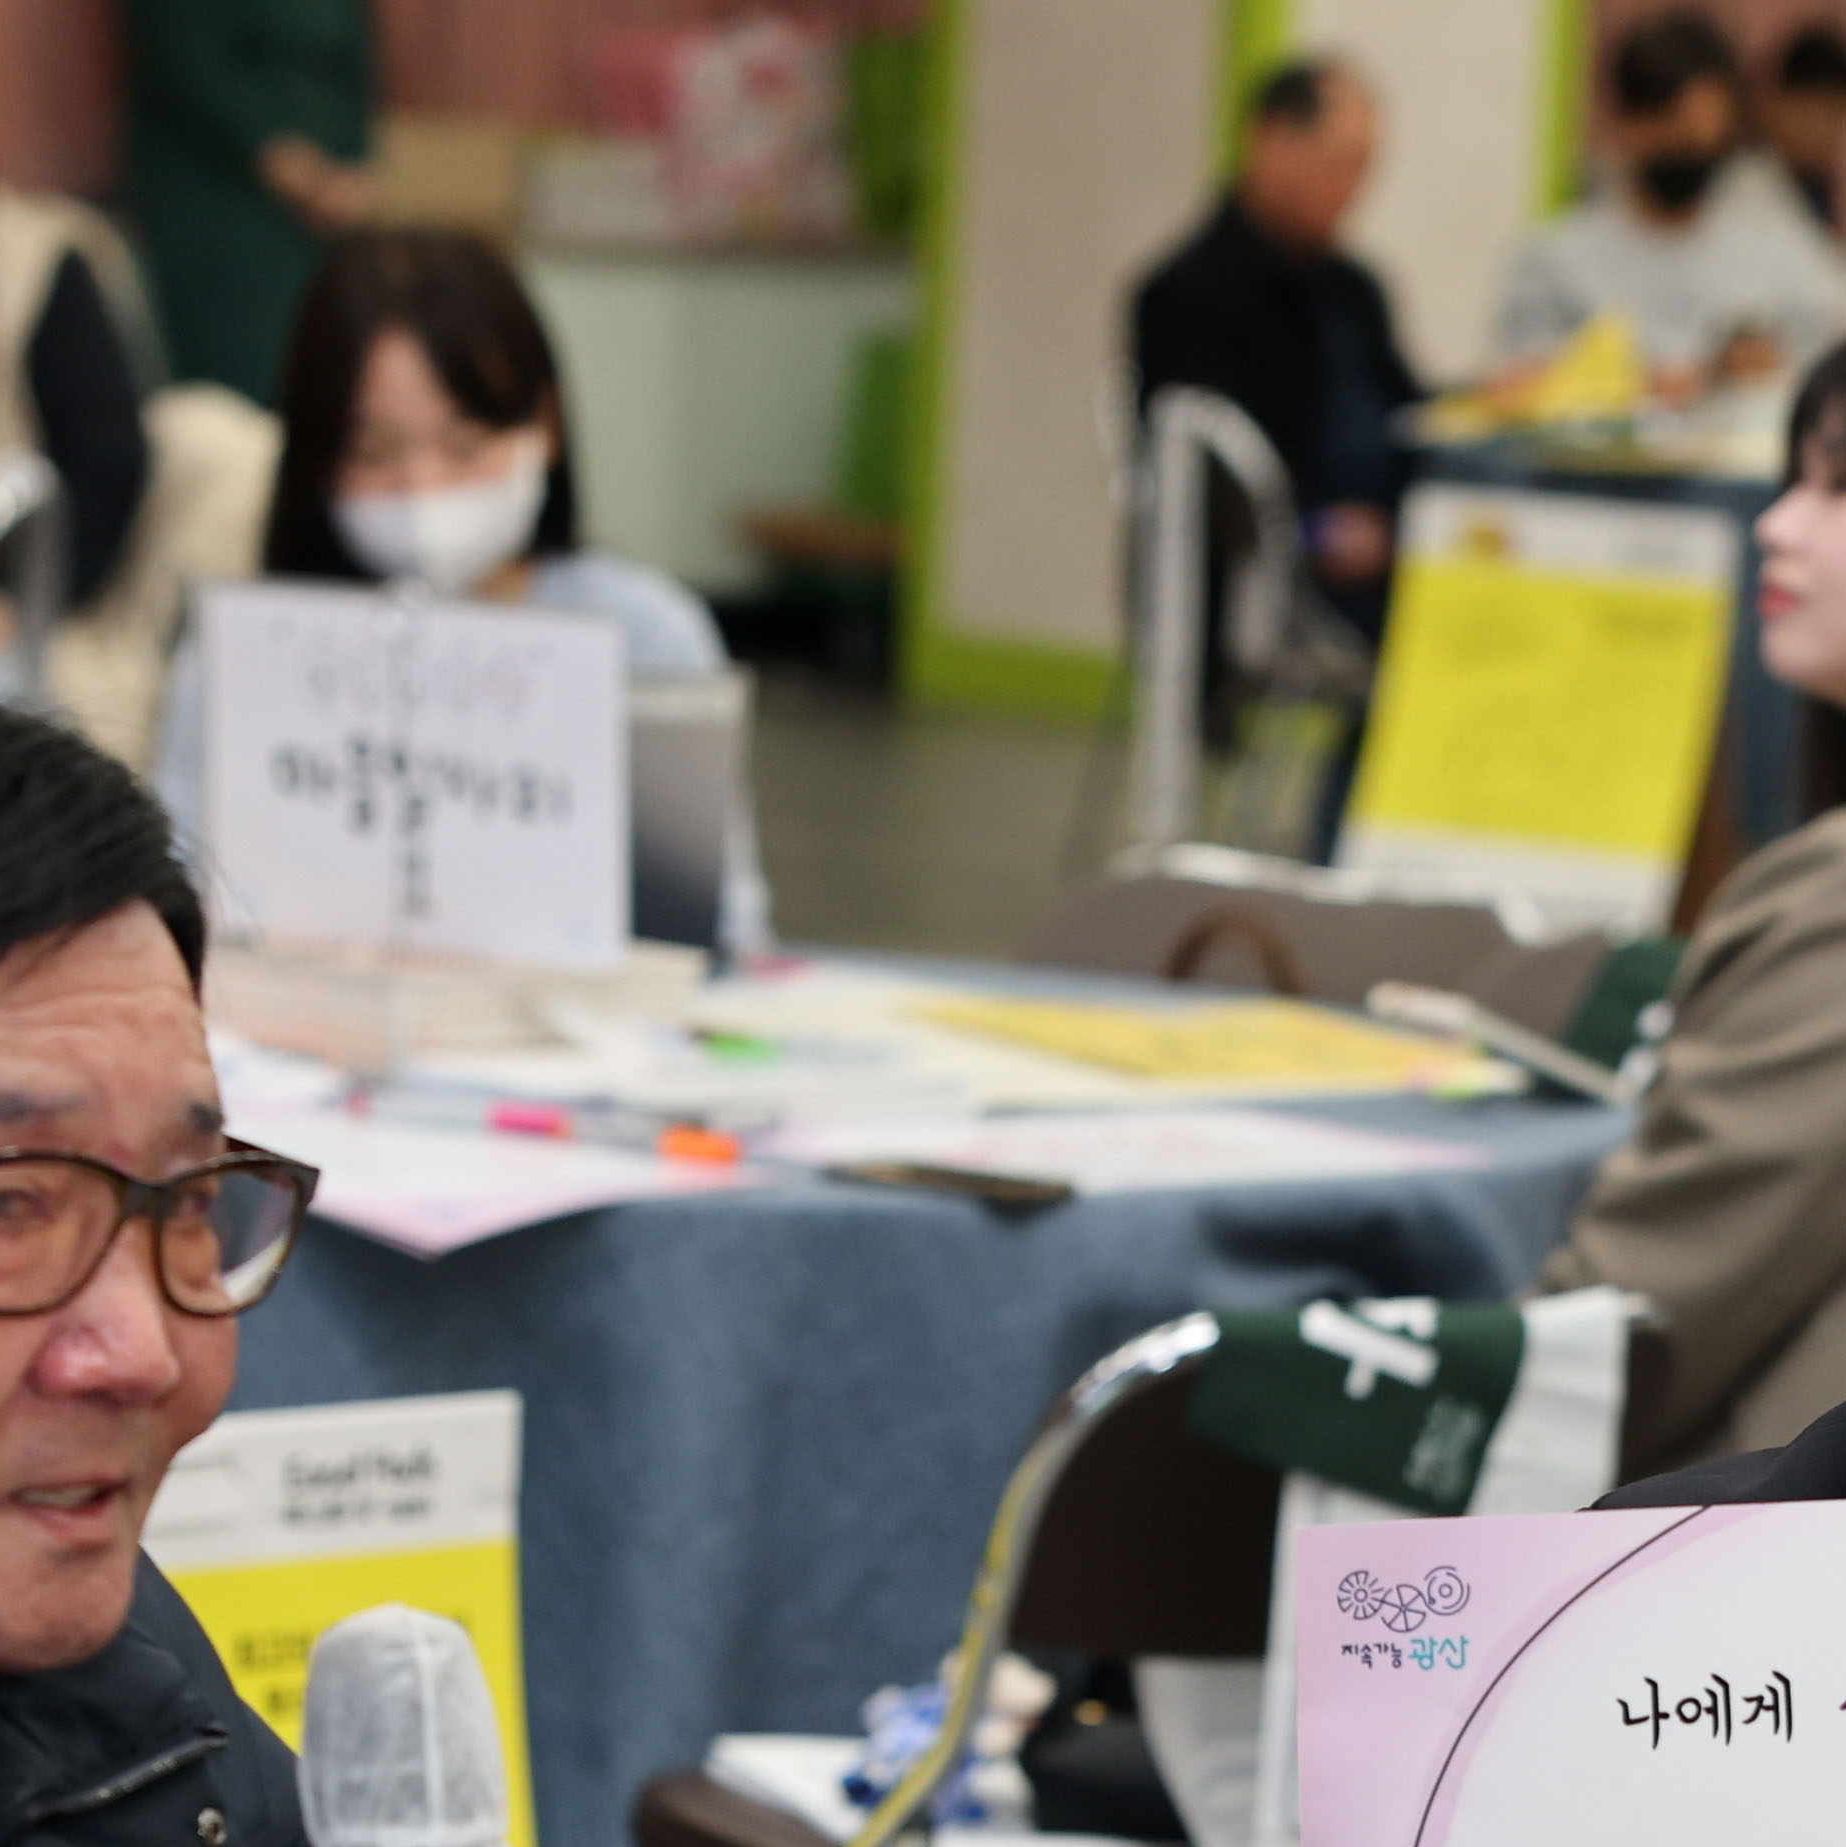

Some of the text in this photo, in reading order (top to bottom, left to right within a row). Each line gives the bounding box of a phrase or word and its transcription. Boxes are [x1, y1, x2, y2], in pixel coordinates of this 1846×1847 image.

[1341, 1635, 1469, 1671] 지속가능 광산
[1616, 1670, 1793, 1750] 나에게
